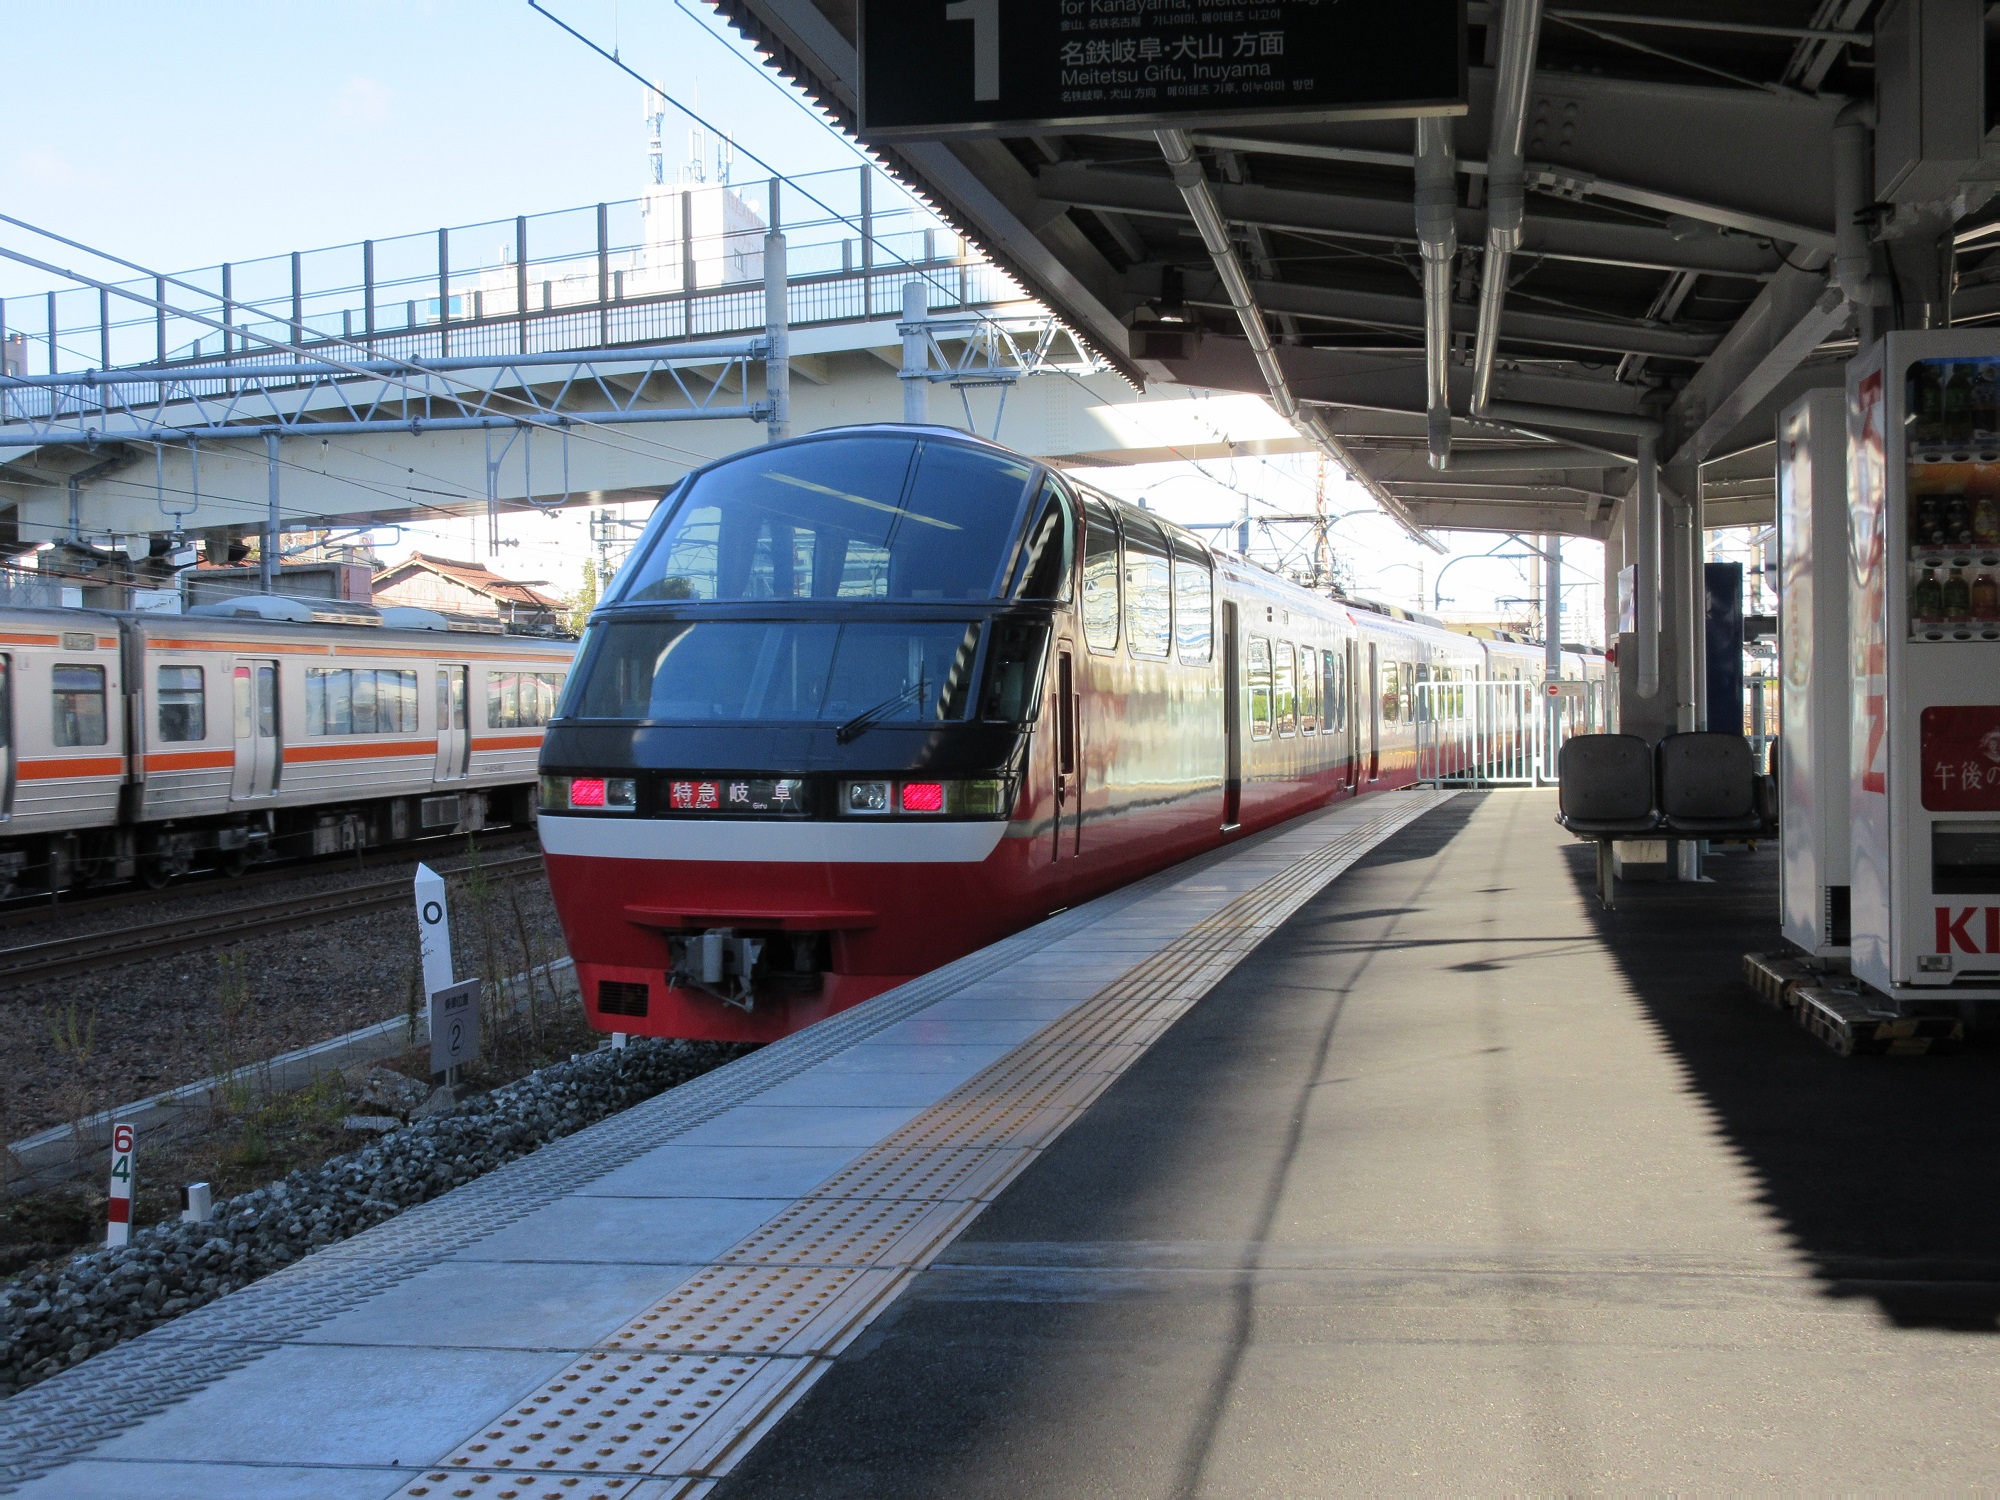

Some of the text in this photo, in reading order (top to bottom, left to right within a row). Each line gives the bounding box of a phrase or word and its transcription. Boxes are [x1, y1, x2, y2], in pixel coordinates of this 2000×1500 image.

[1060, 0, 1085, 14] for
[1090, 0, 1191, 14] Kanayama,
[946, 0, 999, 101] 1
[1232, 30, 1285, 57] 方面
[1061, 63, 1271, 86] Meitetsu Gifu, Inuyama
[1933, 761, 2000, 791] 午後の
[673, 782, 717, 803] 特急
[1935, 906, 2000, 954] KI
[114, 1125, 134, 1153] 6
[112, 1155, 131, 1184] 4
